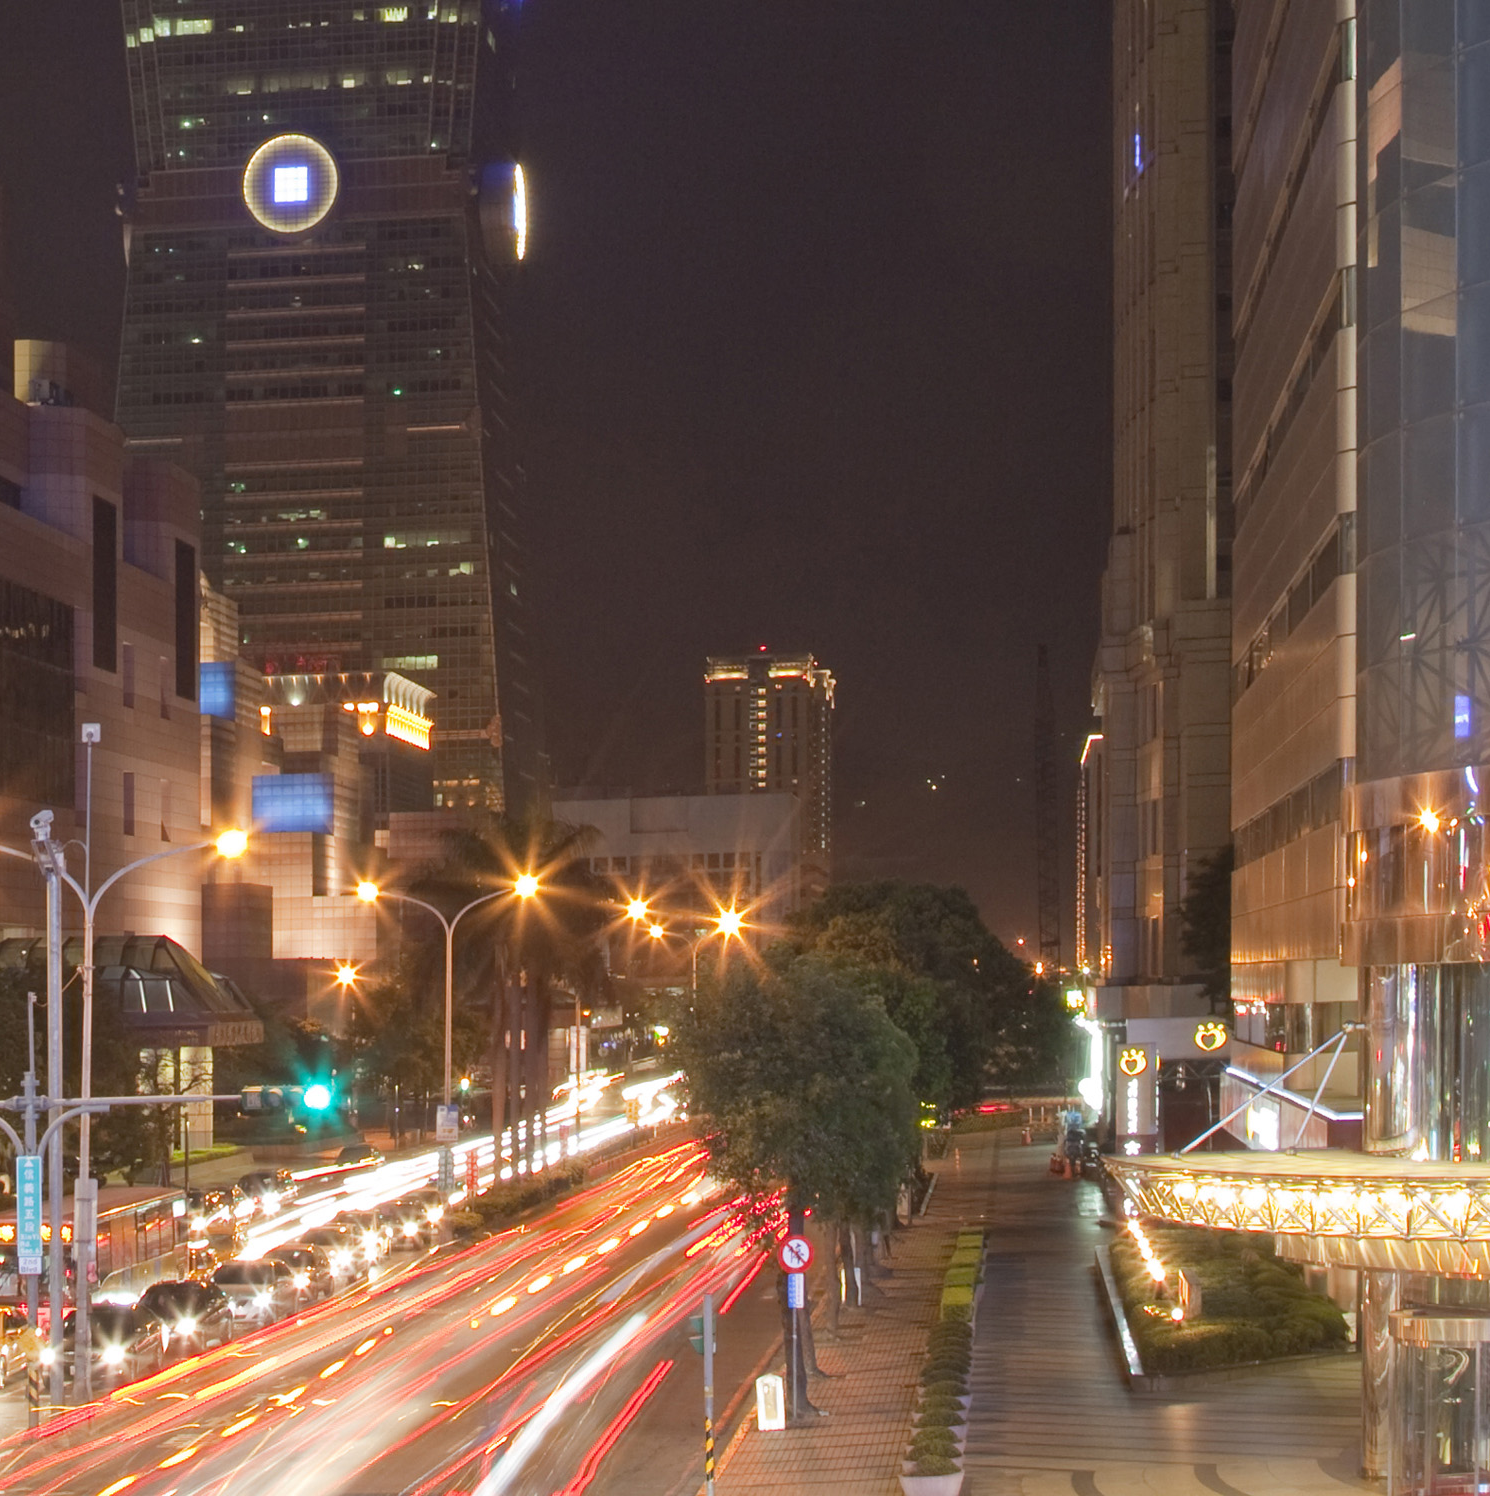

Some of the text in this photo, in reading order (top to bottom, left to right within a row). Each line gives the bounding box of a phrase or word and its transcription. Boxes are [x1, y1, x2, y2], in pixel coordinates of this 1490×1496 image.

[23, 1169, 36, 1233] 信義路五段
